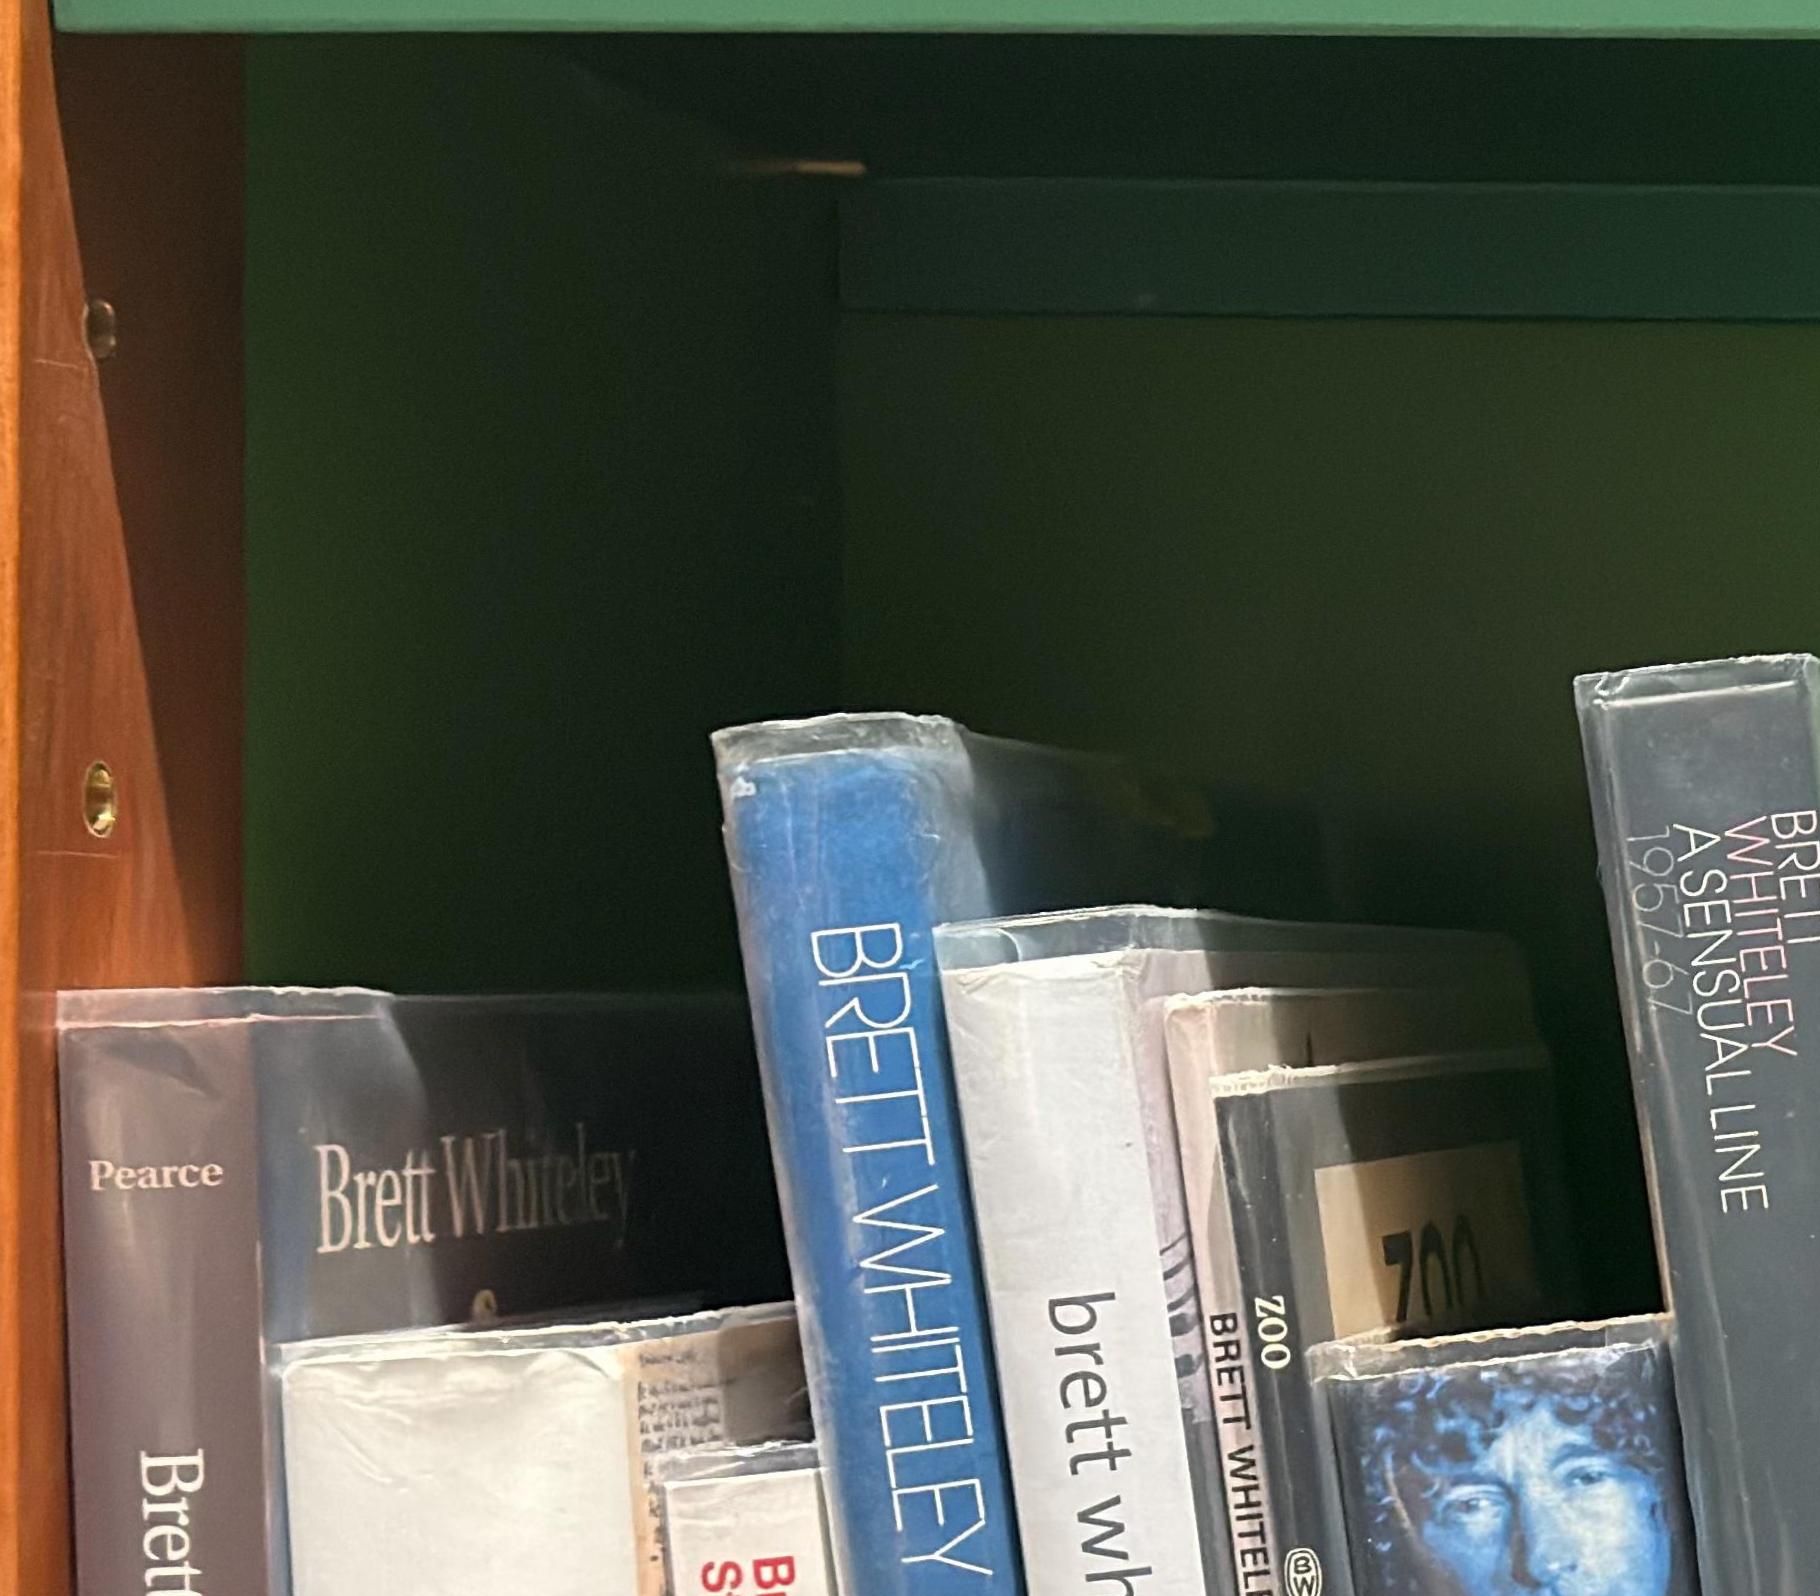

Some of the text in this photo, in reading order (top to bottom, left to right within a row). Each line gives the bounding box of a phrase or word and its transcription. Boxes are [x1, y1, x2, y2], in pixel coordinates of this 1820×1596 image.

[1673, 823, 1769, 1214] A SENSUAL LINE
[1725, 816, 1798, 1057] WHITELEY
[89, 1158, 224, 1192] Pearce
[315, 1122, 636, 1255] Brett Whiteley
[810, 922, 993, 1577] BRETT WHITELEY
[1048, 1291, 1133, 1476] brett
[1210, 1312, 1252, 1430] BRETT
